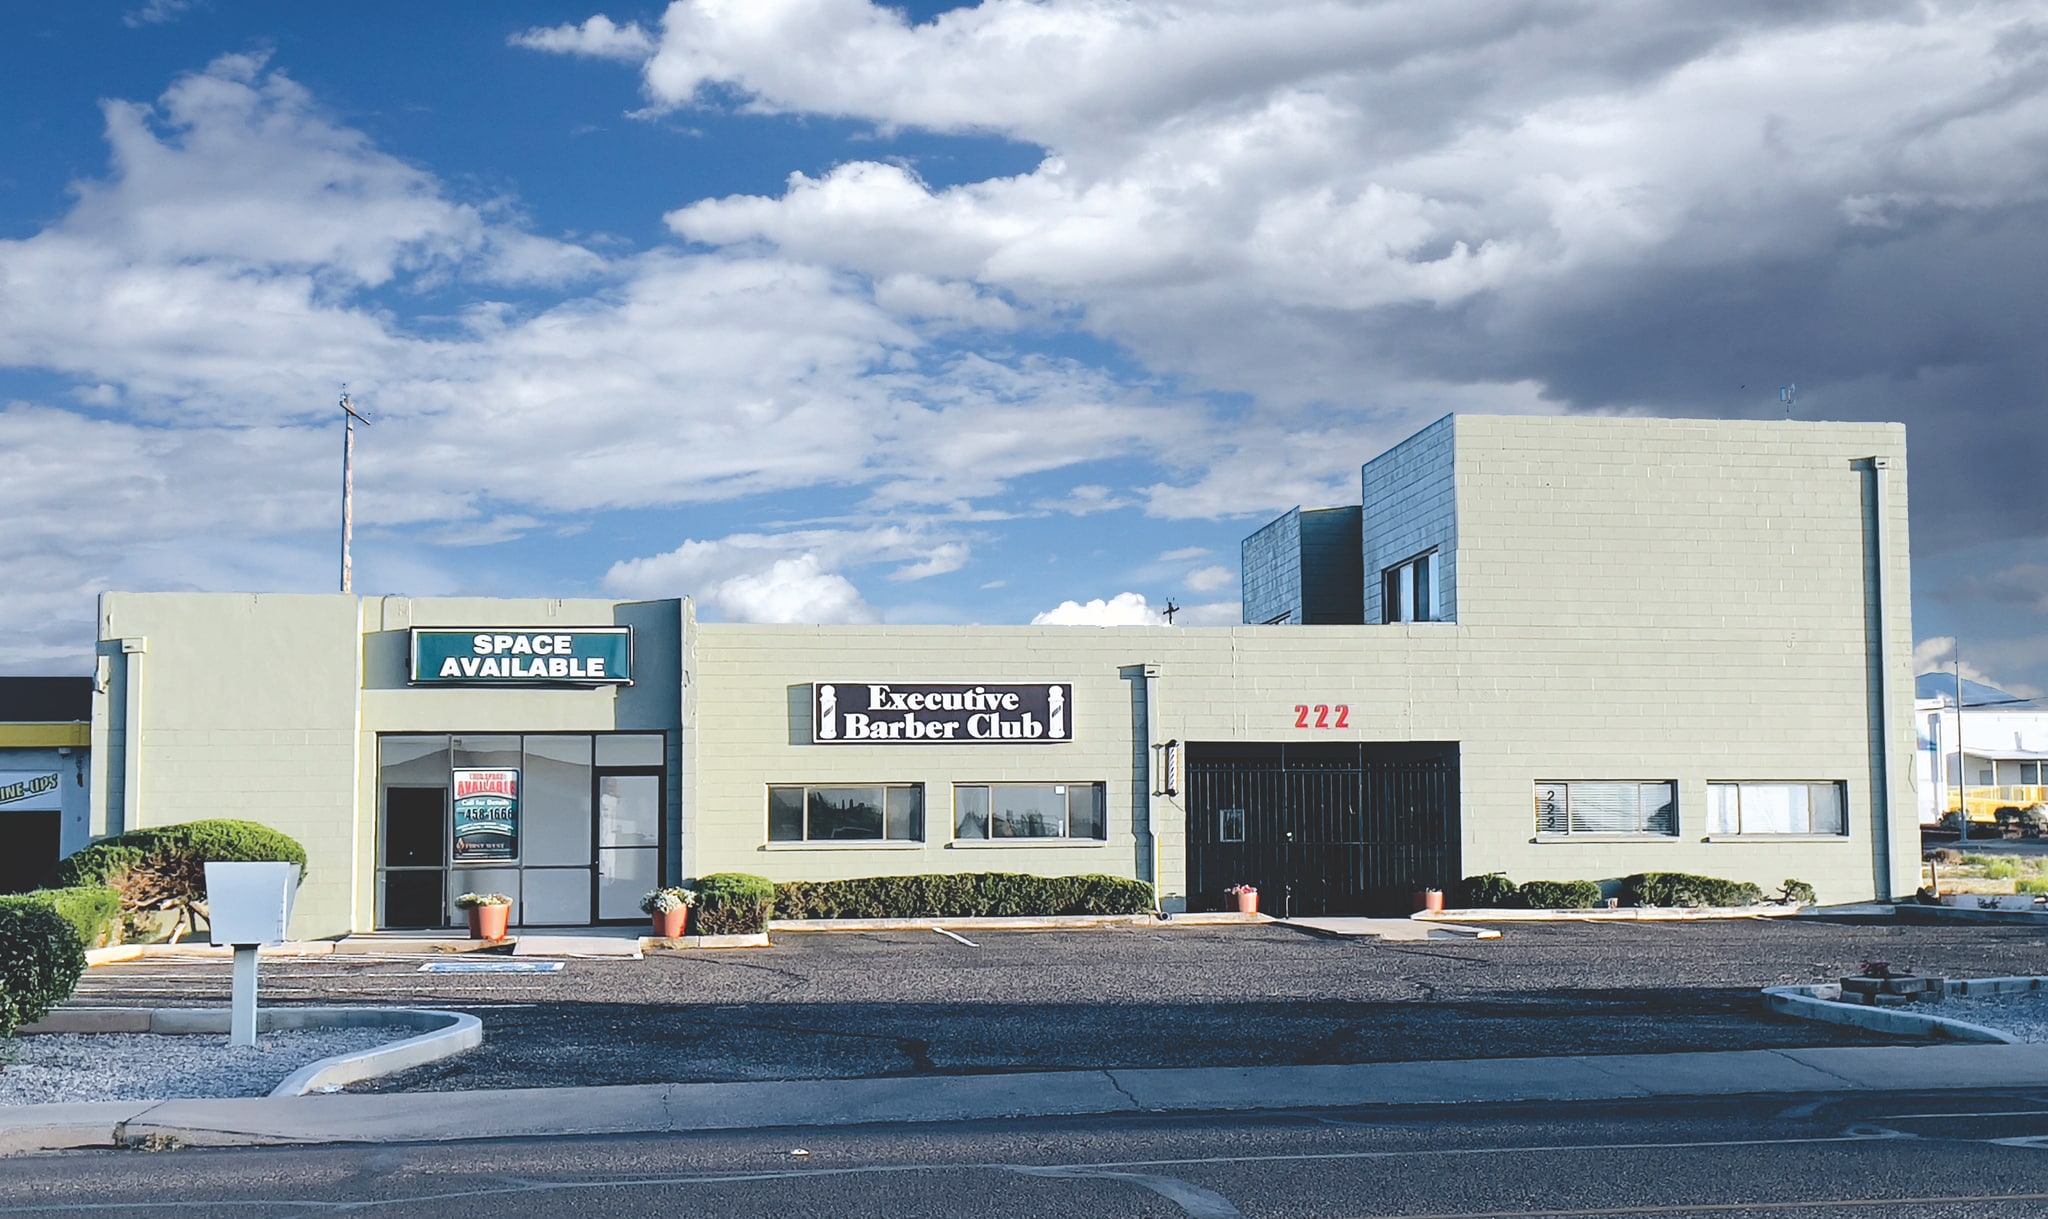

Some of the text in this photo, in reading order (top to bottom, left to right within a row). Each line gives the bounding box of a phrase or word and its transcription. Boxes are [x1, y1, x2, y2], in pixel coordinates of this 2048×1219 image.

[473, 634, 572, 655] SPACE
[439, 657, 605, 677] AVAILABLE
[867, 685, 1020, 711] Executive
[843, 712, 1043, 739] Barber Club
[1294, 704, 1349, 728] 222
[457, 780, 516, 797] AVAILABLE
[465, 808, 513, 820] 458-1666
